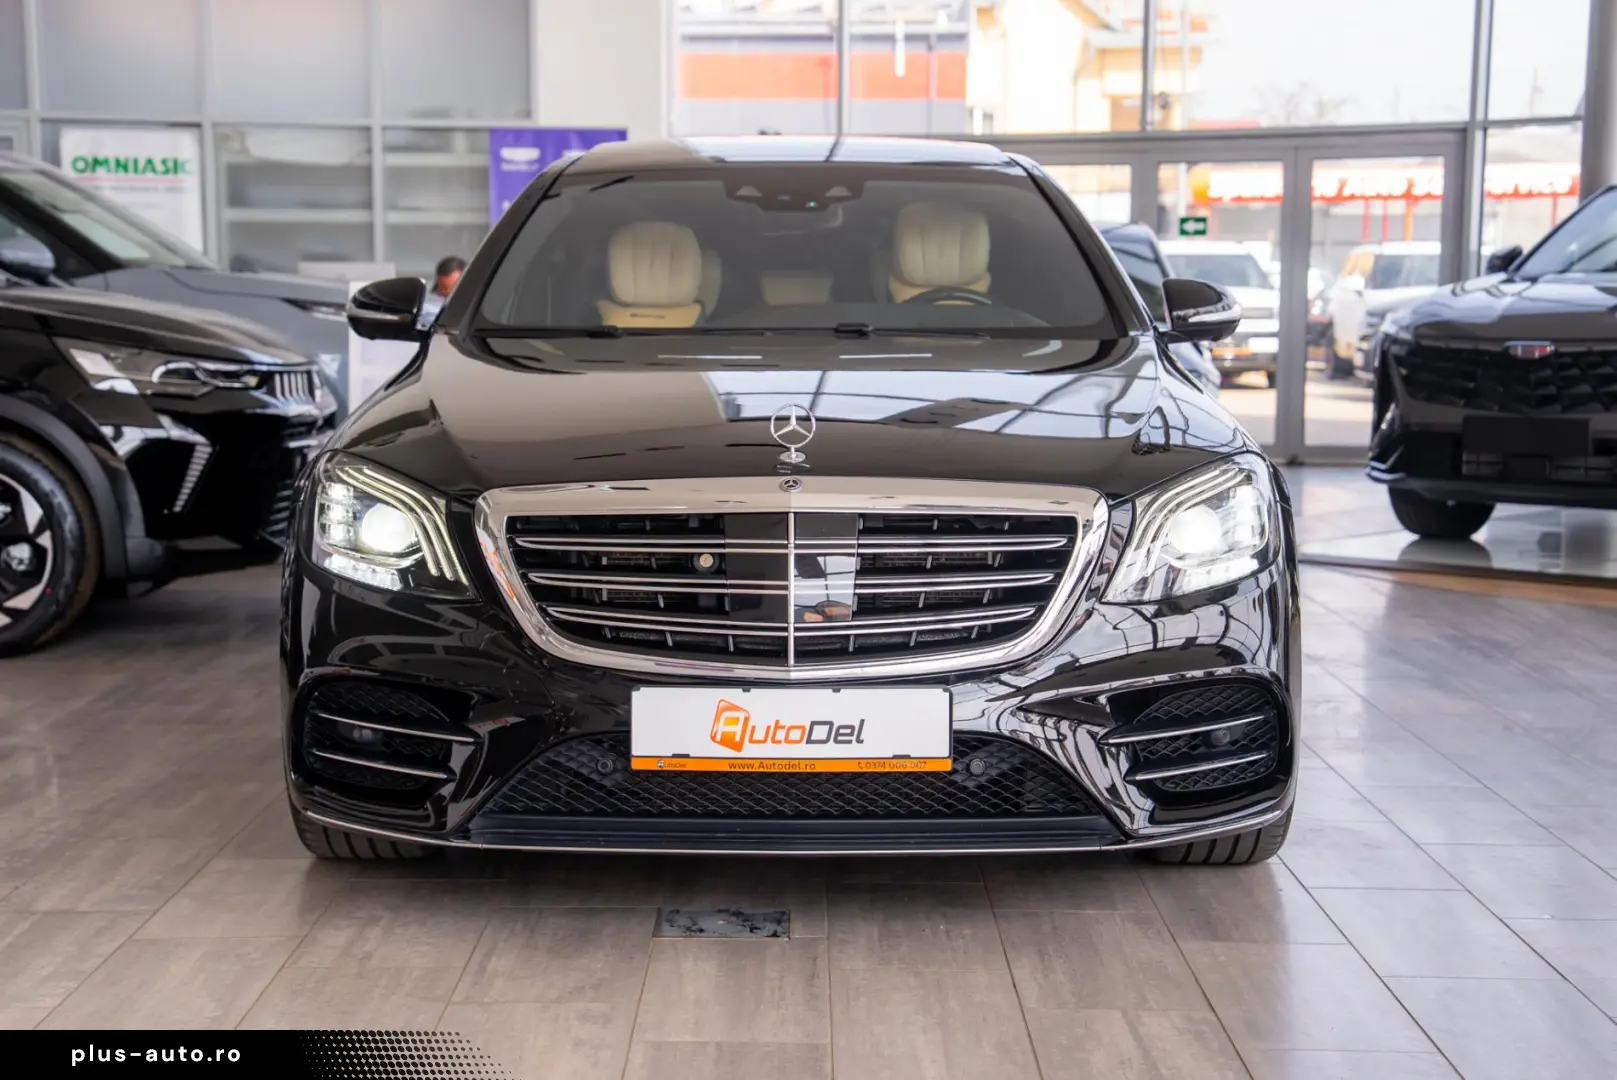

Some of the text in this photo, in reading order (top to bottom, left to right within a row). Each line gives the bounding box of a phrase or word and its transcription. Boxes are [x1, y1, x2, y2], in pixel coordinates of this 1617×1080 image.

[714, 708, 866, 746] AutoDel
[728, 761, 816, 770] www.Autodel.ro
[865, 761, 886, 769] 0374
